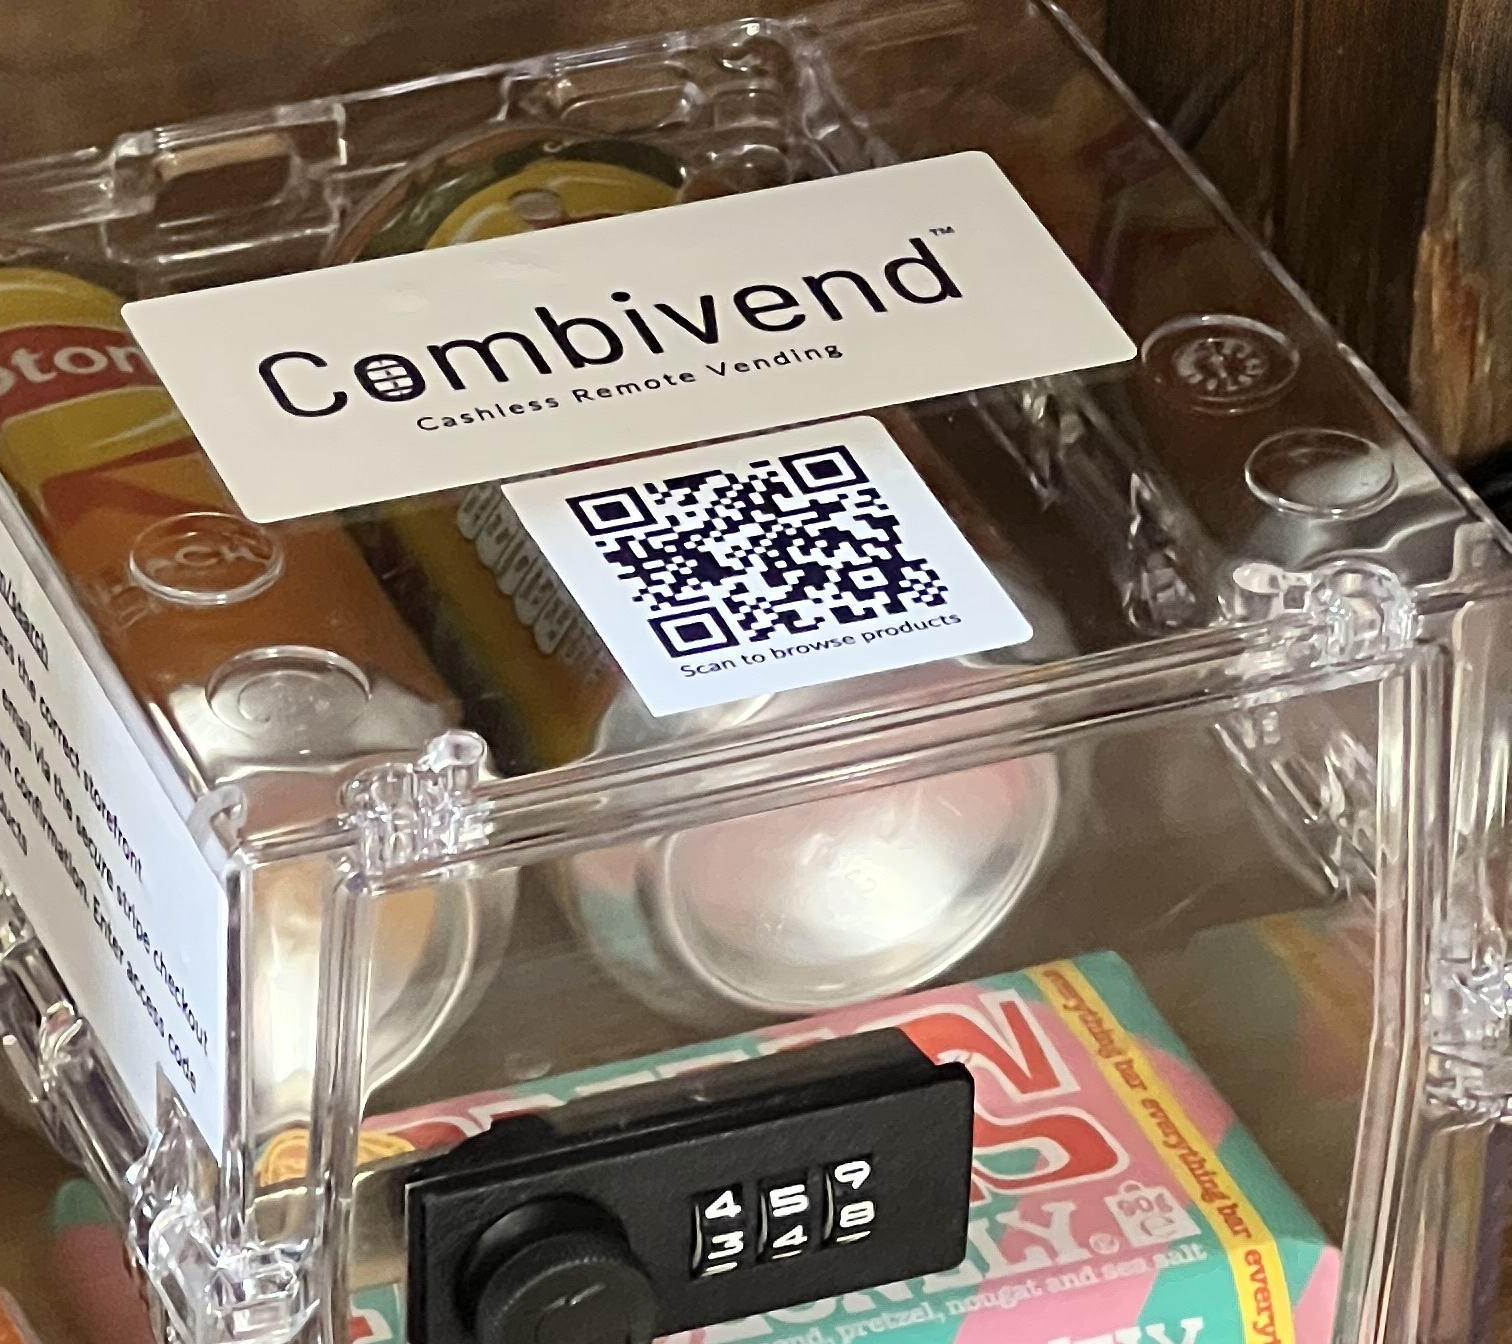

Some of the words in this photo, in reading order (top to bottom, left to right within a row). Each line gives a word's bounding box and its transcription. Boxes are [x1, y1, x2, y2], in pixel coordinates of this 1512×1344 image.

[256, 236, 964, 420] Combivend
[417, 391, 561, 432] Cashless
[573, 367, 696, 404] Remote
[705, 340, 844, 384] Vending
[680, 655, 736, 677] Scan
[742, 649, 766, 665] to
[771, 633, 856, 660] browse
[862, 612, 962, 644] products
[17, 654, 36, 702] the
[39, 696, 80, 777] correct
[83, 770, 141, 880] storefront
[1, 688, 31, 750] email
[34, 742, 50, 783] via
[53, 773, 72, 821] the
[75, 814, 113, 890] secure
[116, 885, 149, 953] stripe
[153, 950, 207, 1054] checkout
[14, 767, 88, 906] confirmation.
[93, 894, 123, 963] Enter
[126, 961, 164, 1037] access
[168, 1033, 195, 1092] code
[704, 1189, 742, 1219] 4
[768, 1183, 810, 1218] 5
[834, 1160, 871, 1190] 9
[1114, 1052, 1148, 1091] bar
[1141, 1097, 1226, 1205] everything
[1216, 1201, 1255, 1241] bar
[707, 1230, 744, 1260] 3
[772, 1224, 808, 1249] 4
[839, 1200, 876, 1228] 8
[947, 1283, 1043, 1318] nougat
[1045, 1268, 1096, 1294] and
[1100, 1258, 1148, 1281] sea
[1153, 1243, 1208, 1270] salt
